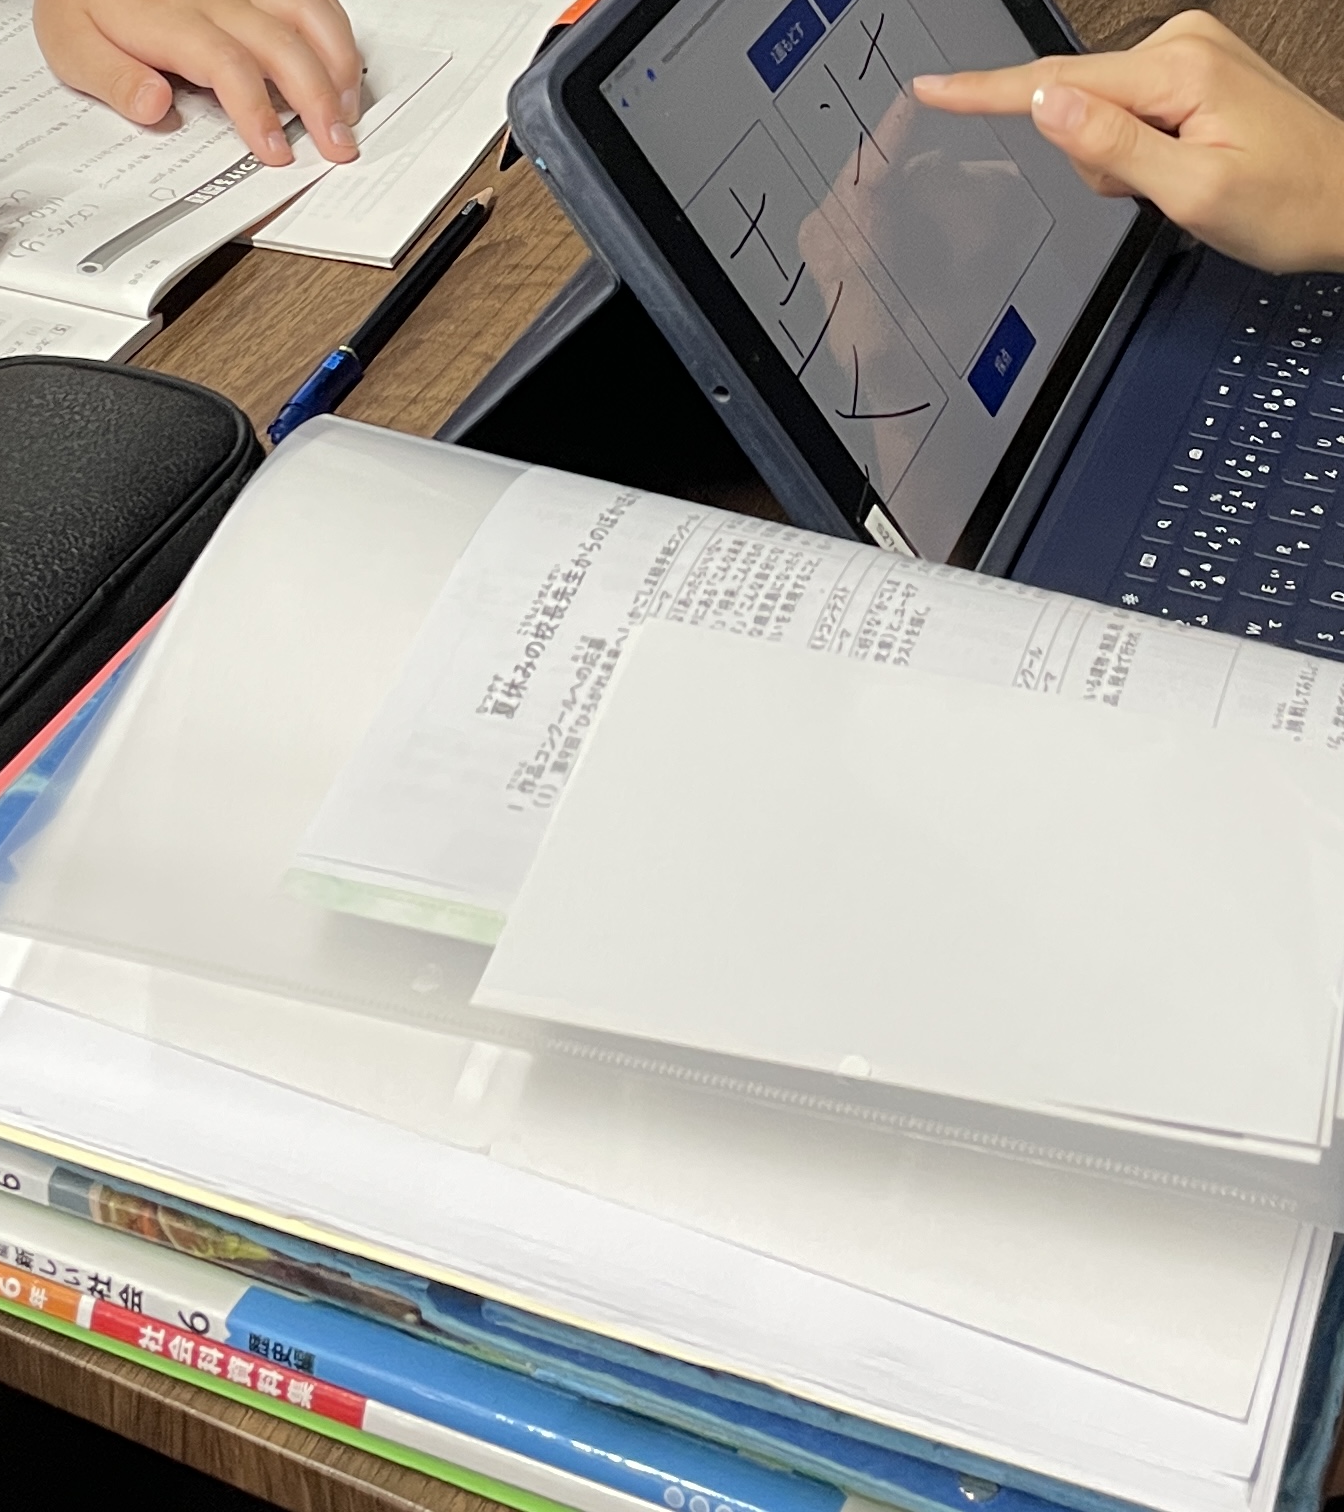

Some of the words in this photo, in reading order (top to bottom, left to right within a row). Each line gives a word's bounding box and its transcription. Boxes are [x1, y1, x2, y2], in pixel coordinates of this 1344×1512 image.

[178, 1310, 211, 1335] 6
[138, 1325, 316, 1409] 社会科資料集
